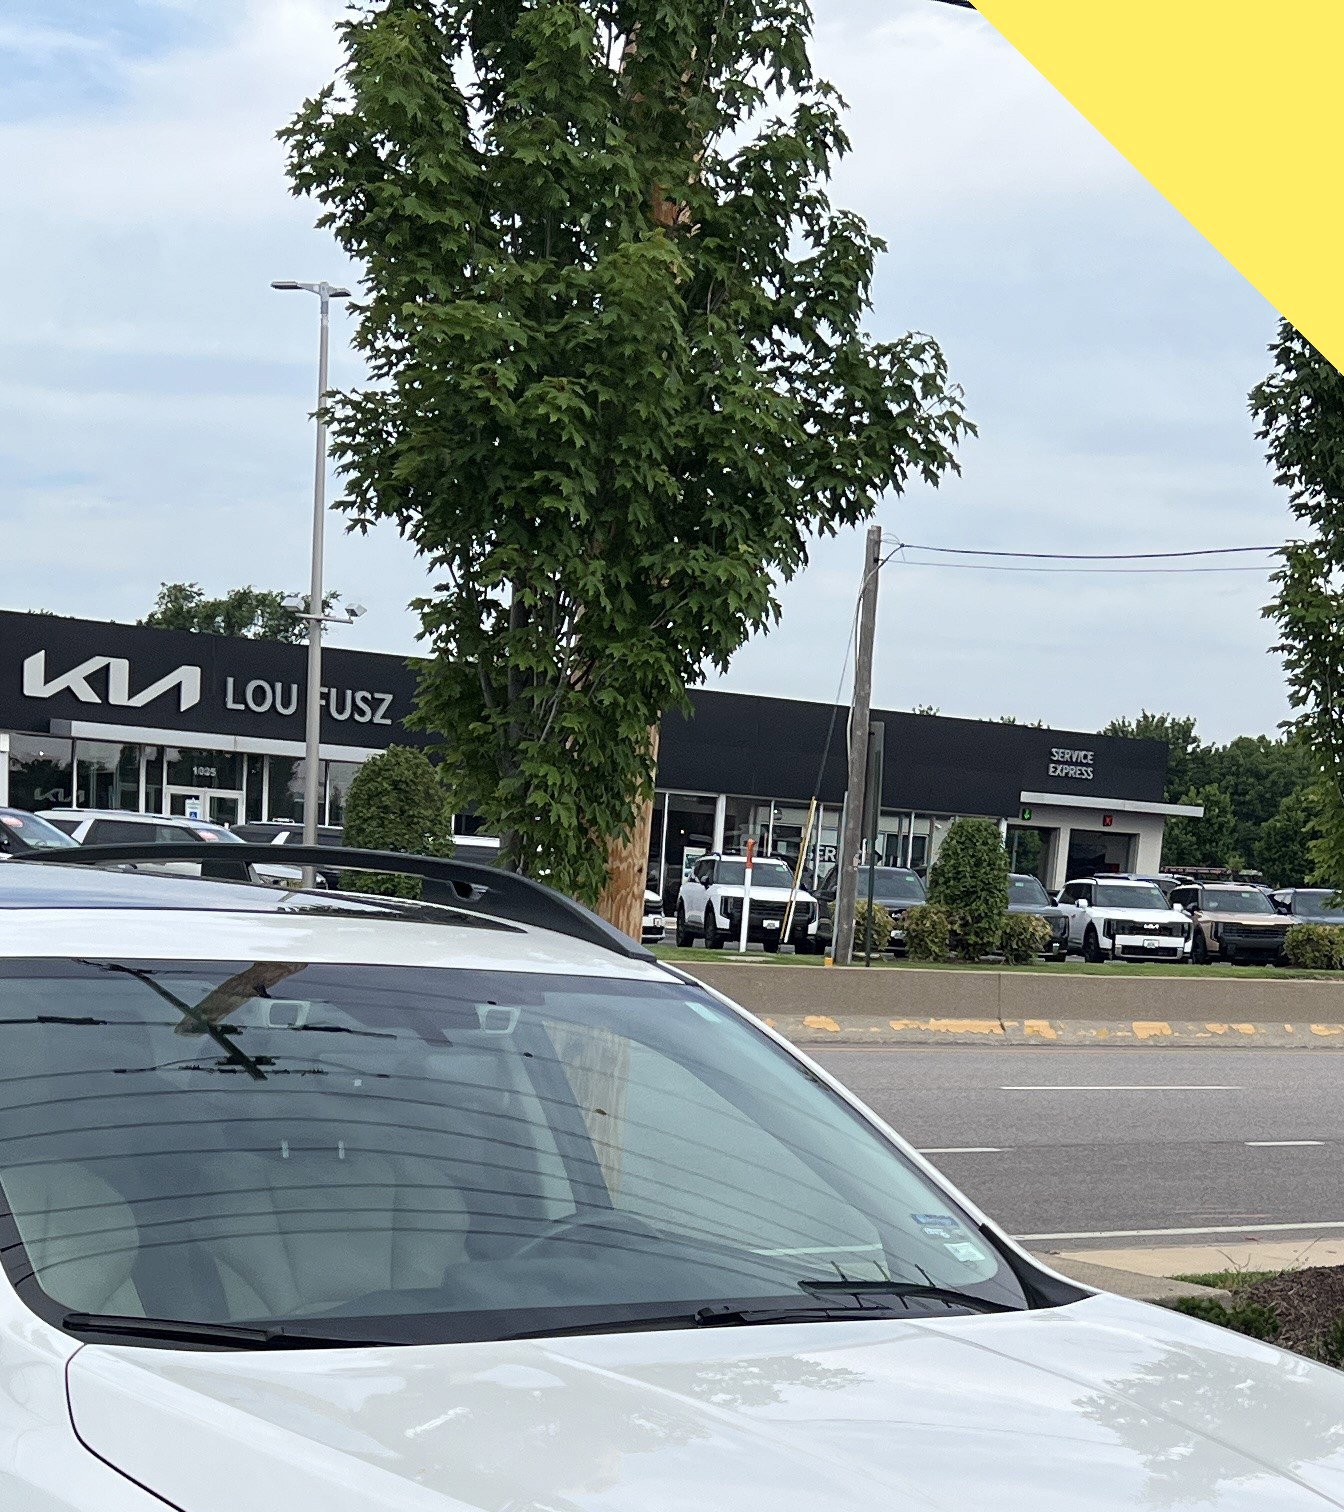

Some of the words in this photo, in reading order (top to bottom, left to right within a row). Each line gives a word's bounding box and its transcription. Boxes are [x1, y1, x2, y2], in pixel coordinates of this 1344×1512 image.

[225, 675, 299, 716] LOU
[1050, 747, 1095, 764] SERVICE
[1048, 763, 1094, 780] EXPRESS
